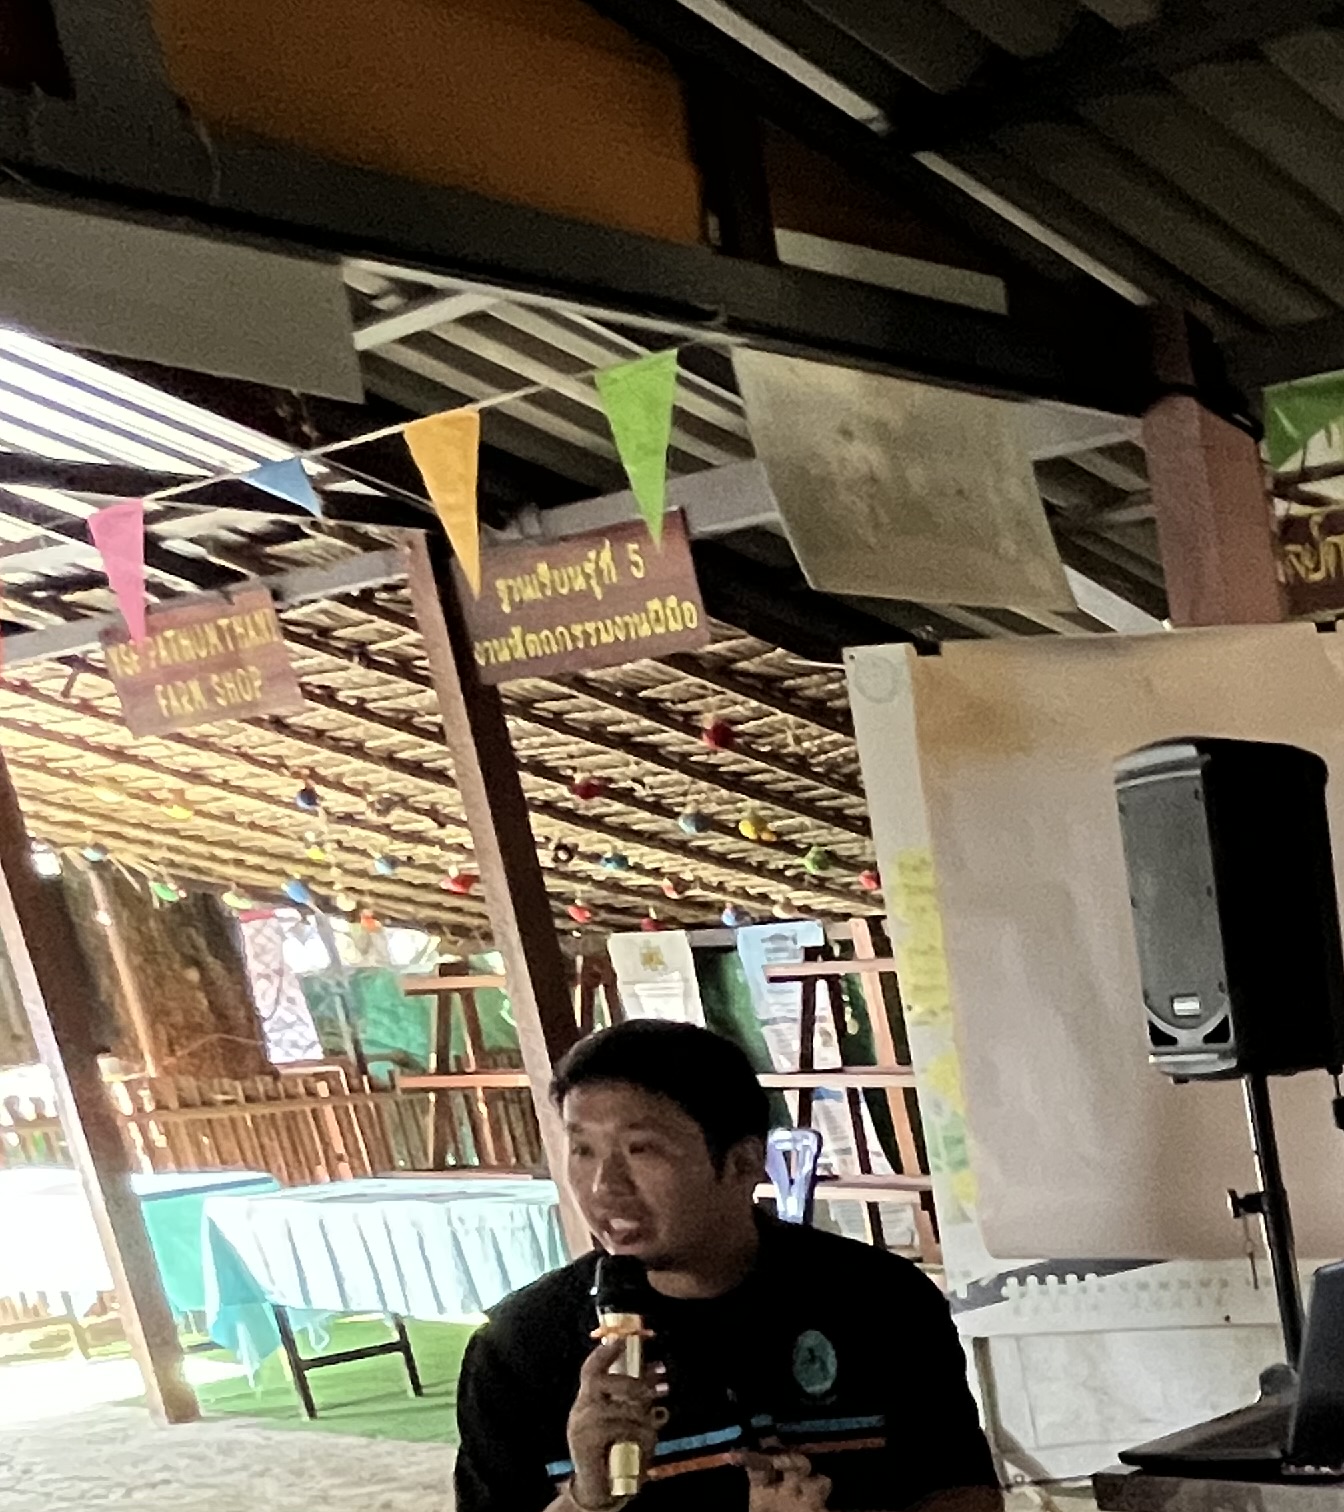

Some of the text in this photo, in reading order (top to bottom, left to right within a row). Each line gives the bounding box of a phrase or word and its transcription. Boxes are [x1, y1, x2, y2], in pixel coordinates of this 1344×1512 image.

[626, 542, 645, 579] 5
[154, 665, 263, 719] FARM SHOP
